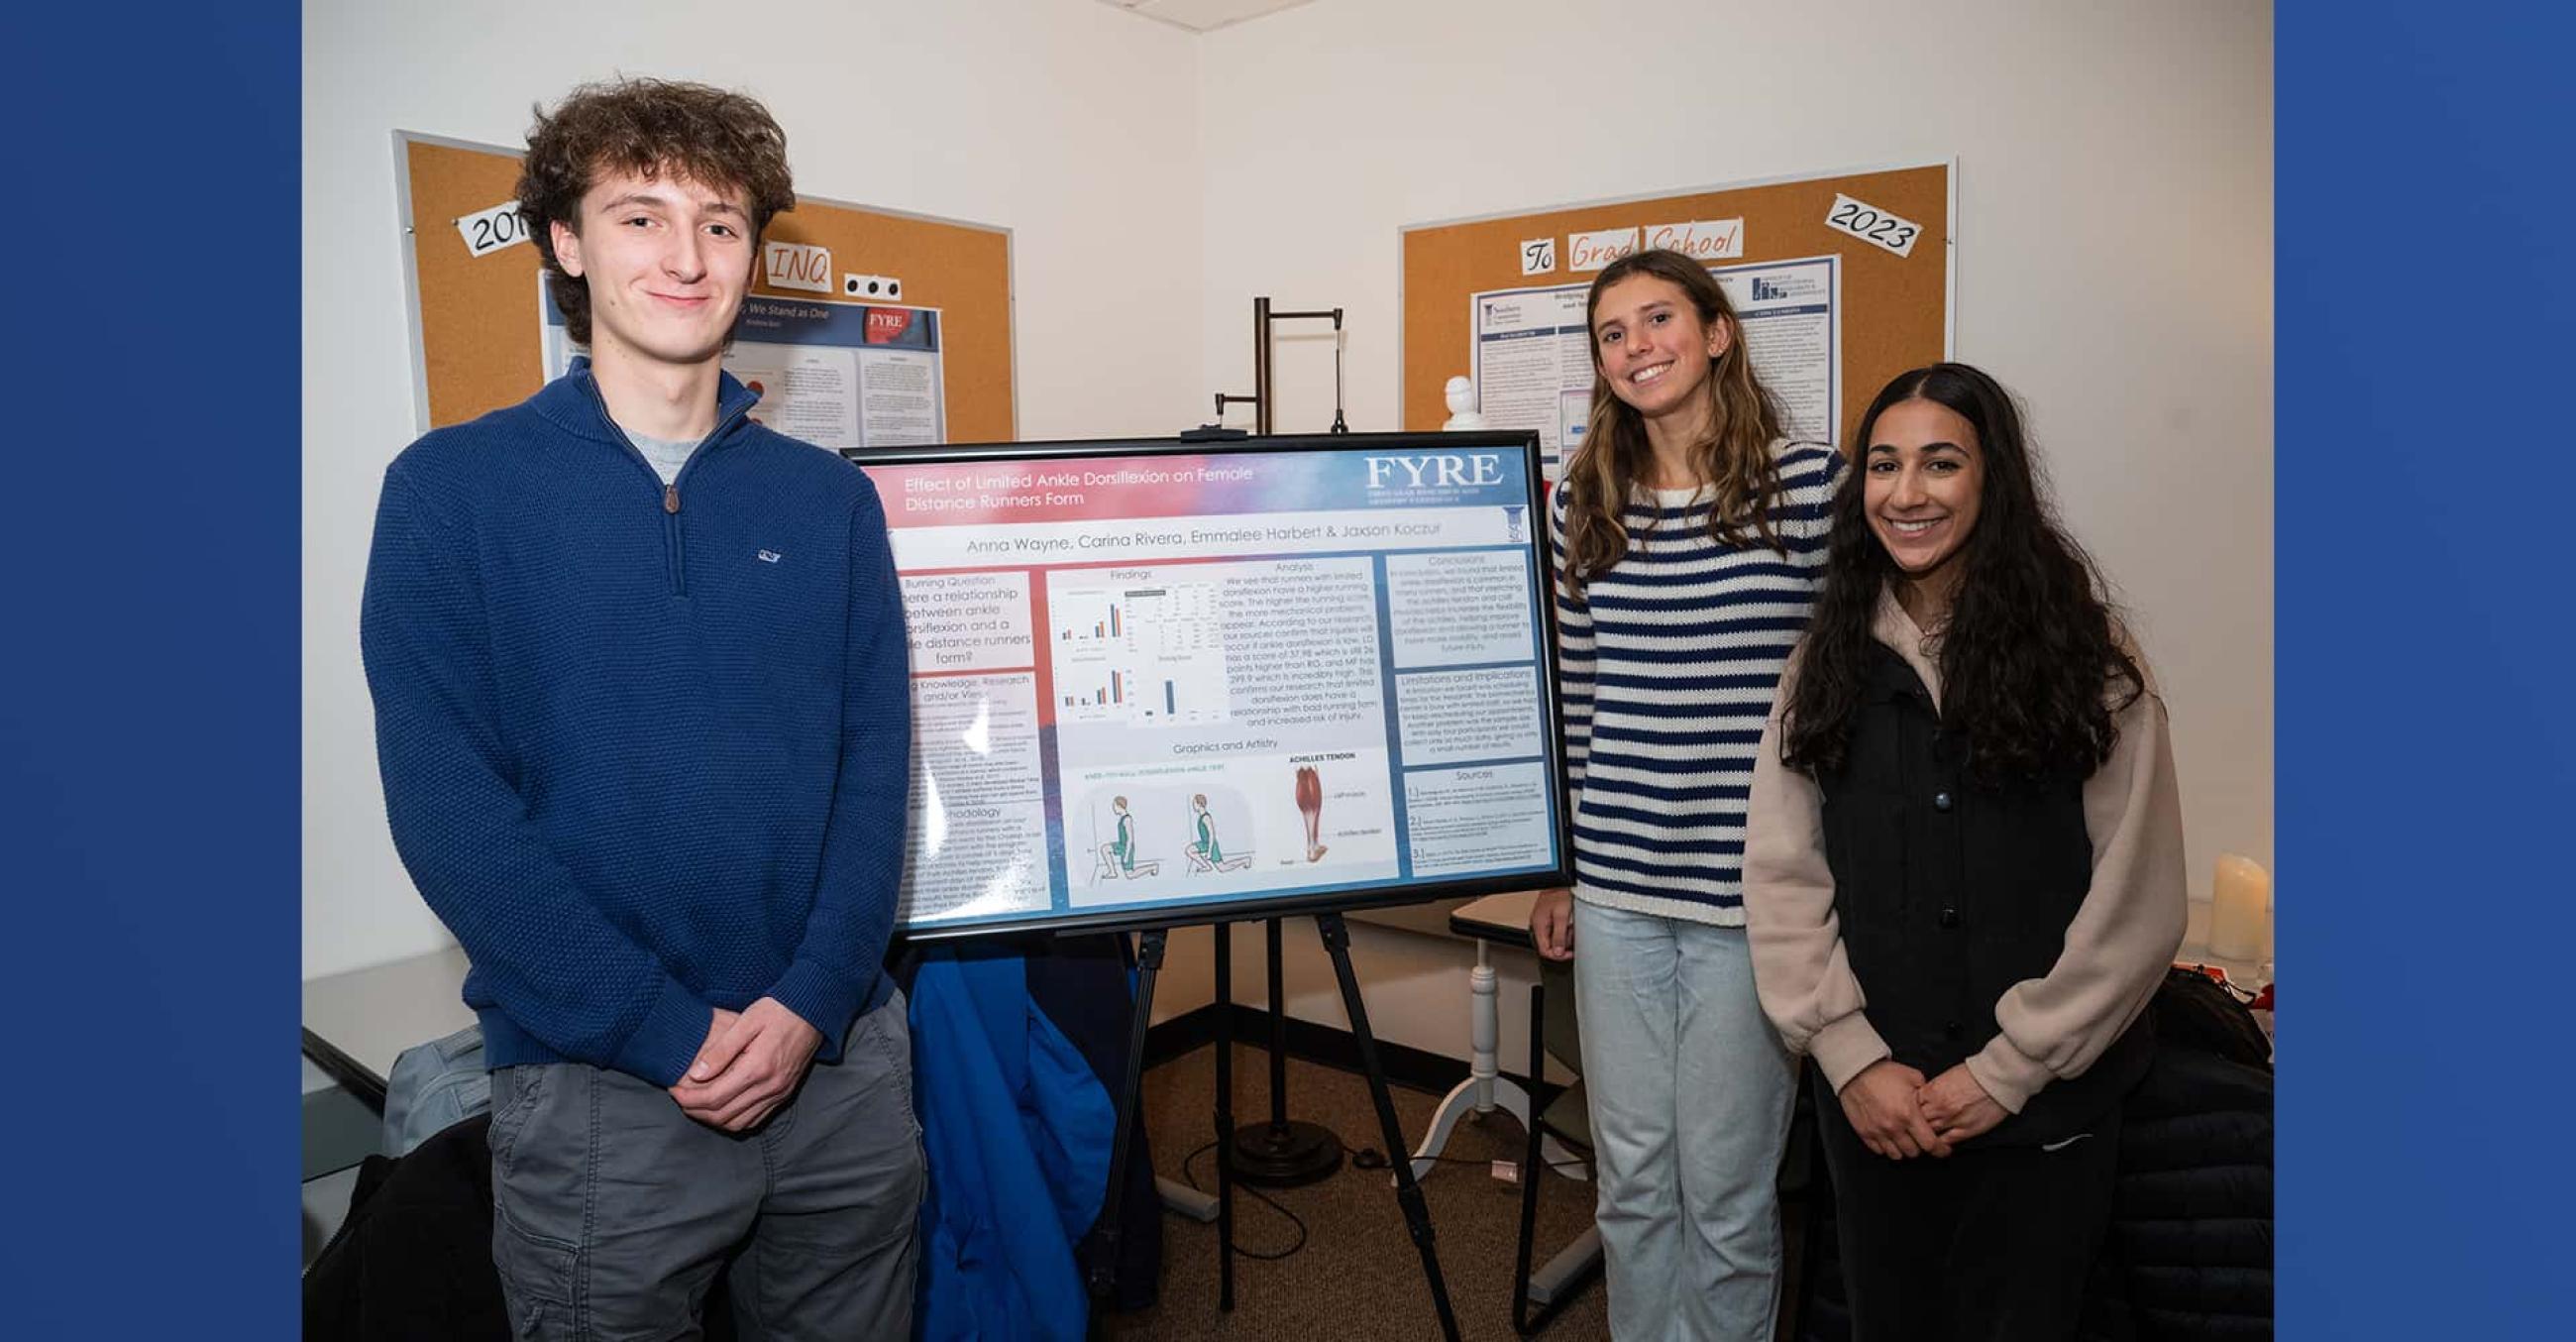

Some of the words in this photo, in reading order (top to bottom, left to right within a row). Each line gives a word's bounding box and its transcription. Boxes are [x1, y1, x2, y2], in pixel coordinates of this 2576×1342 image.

[1832, 204, 1914, 248] 2023
[1527, 242, 1553, 271] To
[1572, 234, 1636, 268] Grad
[769, 248, 827, 283] INQ
[868, 313, 903, 327] FYRE
[1362, 453, 1504, 489] FYRE
[904, 475, 951, 493] Effect
[958, 475, 971, 492] of
[975, 473, 1031, 491] Limited
[1036, 472, 1080, 489] Ankle
[1084, 469, 1168, 488] Dorsiflexion
[1172, 473, 1193, 485] on
[1197, 467, 1253, 485] Female
[905, 495, 975, 511] Distance
[979, 493, 1041, 508] Runners
[1045, 492, 1084, 506] Form
[965, 536, 1010, 554] Anna
[1014, 534, 1074, 553] Wayne,
[1078, 532, 1131, 550] Carina
[1134, 530, 1186, 548] Rivera,
[1190, 527, 1261, 546] Emmalee
[1267, 525, 1322, 541] Harbert
[1327, 525, 1337, 539] &
[1342, 523, 1389, 538] Jaxson
[1394, 521, 1443, 536] Koczur
[1276, 562, 1314, 572] Analysis
[1428, 554, 1485, 565] Conclusions
[946, 575, 996, 586] Question
[1110, 569, 1152, 581] Findings
[944, 587, 1019, 604] relationship
[965, 606, 1000, 615] ankle
[909, 621, 966, 634] orsiflexion
[970, 619, 997, 631] and
[924, 636, 981, 649] distance
[984, 634, 1030, 645] runners
[935, 650, 973, 664] form?
[1173, 740, 1220, 756] Graphics
[1222, 740, 1242, 750] and
[1245, 736, 1278, 751] Artistry
[1289, 754, 1325, 764] ACHILLES
[1326, 751, 1355, 761] TENDON
[1455, 768, 1494, 780] Sources
